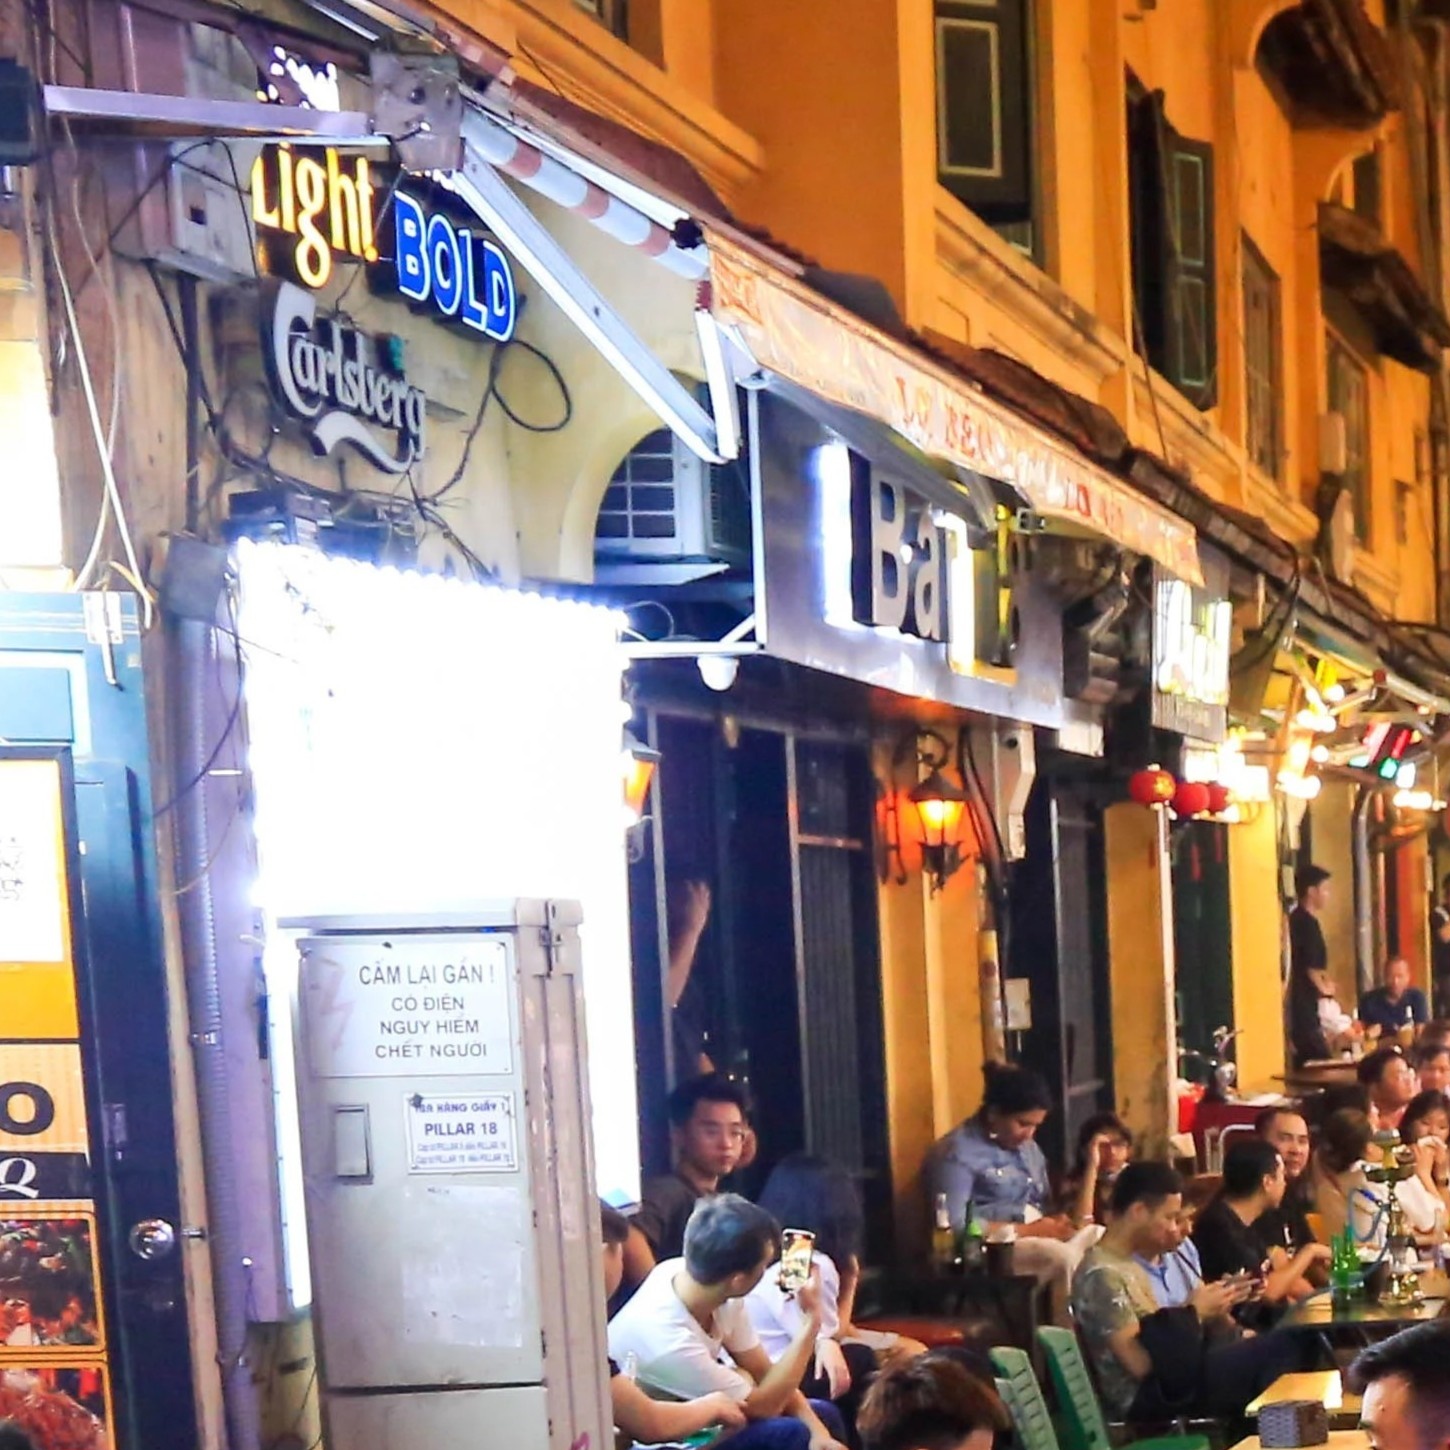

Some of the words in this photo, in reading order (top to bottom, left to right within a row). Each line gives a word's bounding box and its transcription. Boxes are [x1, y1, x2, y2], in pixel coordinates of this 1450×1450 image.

[394, 190, 515, 342] BOLD
[272, 281, 428, 473] Carlsberg
[380, 1020, 430, 1035] NGUY
[375, 1039, 424, 1058] CHẾT
[424, 1122, 475, 1136] PILLAR
[481, 1121, 498, 1135] 18
